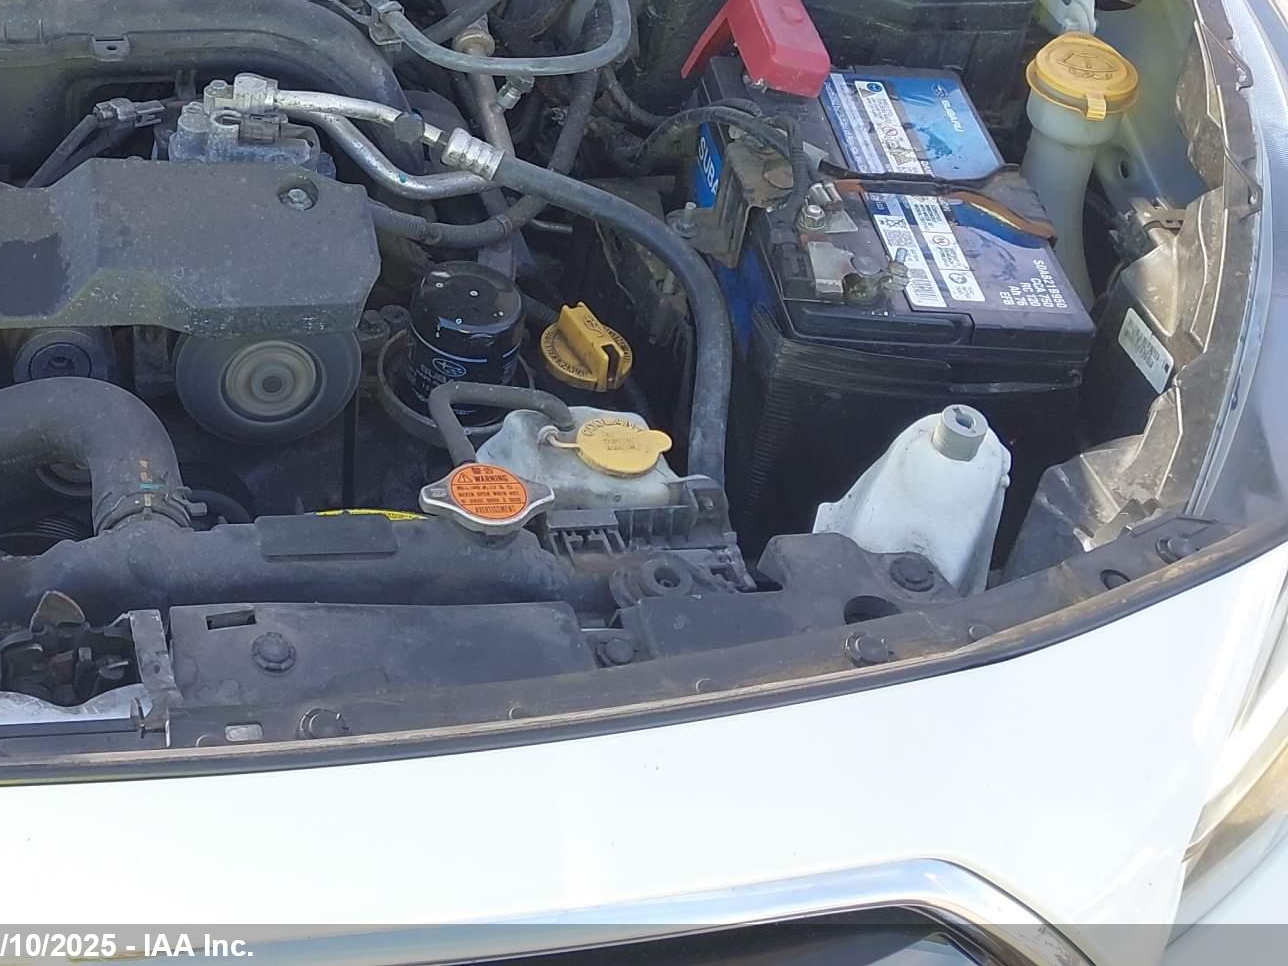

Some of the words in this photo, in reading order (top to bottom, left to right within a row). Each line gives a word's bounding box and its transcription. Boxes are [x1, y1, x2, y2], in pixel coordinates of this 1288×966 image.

[941, 99, 964, 132] SUBARU
[698, 136, 719, 194] SUBA
[1008, 285, 1022, 296] Ah
[1019, 282, 1034, 292] RC
[1030, 277, 1046, 292] CCA
[999, 291, 1015, 305] EFB
[1014, 297, 1028, 306] 76
[1026, 294, 1041, 307] 120
[1037, 294, 1054, 308] 750
[474, 475, 508, 483] WARNING
